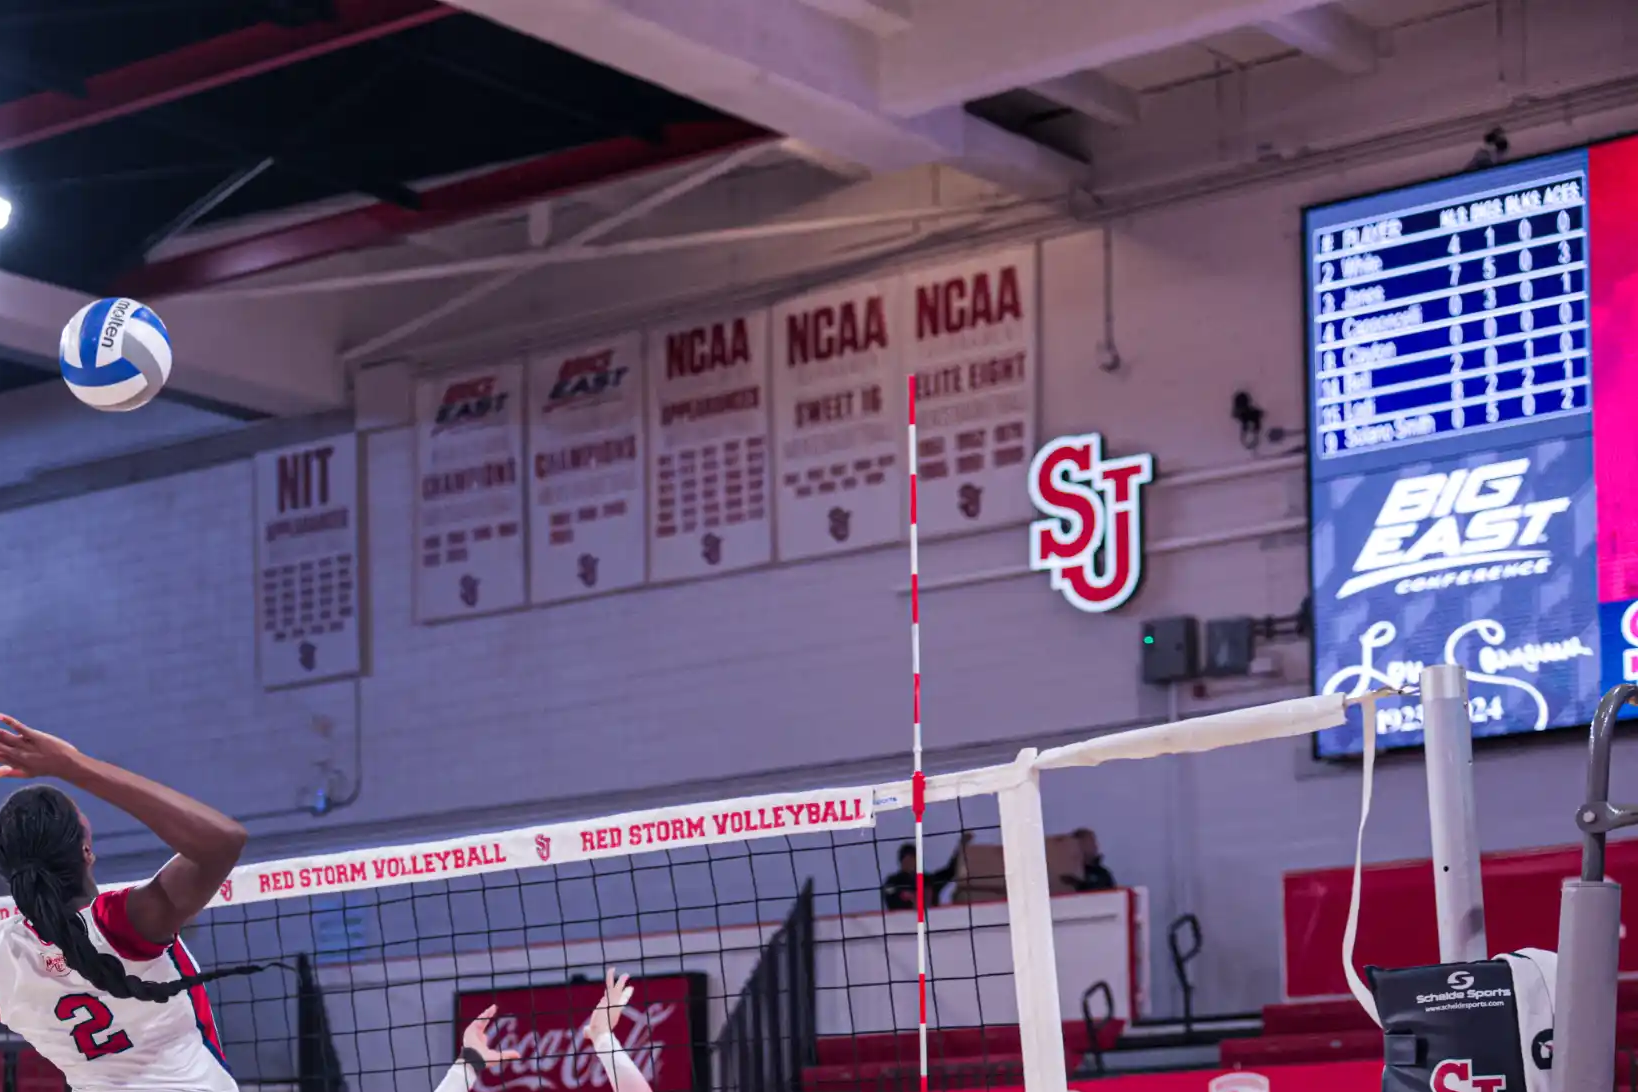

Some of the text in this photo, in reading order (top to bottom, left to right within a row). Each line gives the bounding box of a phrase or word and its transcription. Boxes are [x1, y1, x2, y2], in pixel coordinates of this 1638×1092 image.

[1321, 262, 1333, 282] 2
[1446, 234, 1459, 255] 4
[1481, 226, 1494, 247] 1
[1517, 219, 1530, 240] 0
[1556, 210, 1569, 232] 0
[1447, 264, 1460, 286] 7
[1482, 256, 1495, 279] 5
[1518, 249, 1531, 271] 0
[1557, 241, 1570, 263] 3
[102, 300, 131, 348] molten
[915, 265, 1023, 341] NCAA
[665, 317, 752, 380] NCAA
[785, 296, 888, 369] NCAA
[915, 351, 1026, 401] ELITE EIGHT
[794, 390, 854, 428] SWEET
[277, 446, 334, 514] NIT
[1374, 458, 1530, 528] BIG
[1352, 497, 1571, 572] EAST
[1395, 557, 1552, 595] CONFERENCE
[580, 827, 621, 852] RED
[629, 815, 705, 846] STORM
[712, 798, 865, 836] VOLLEYBALL
[259, 870, 294, 893] RED
[300, 863, 367, 889] STORM
[372, 843, 507, 880] VOLLEYBALL
[1466, 988, 1511, 1000] Sports
[54, 992, 134, 1061] 2
